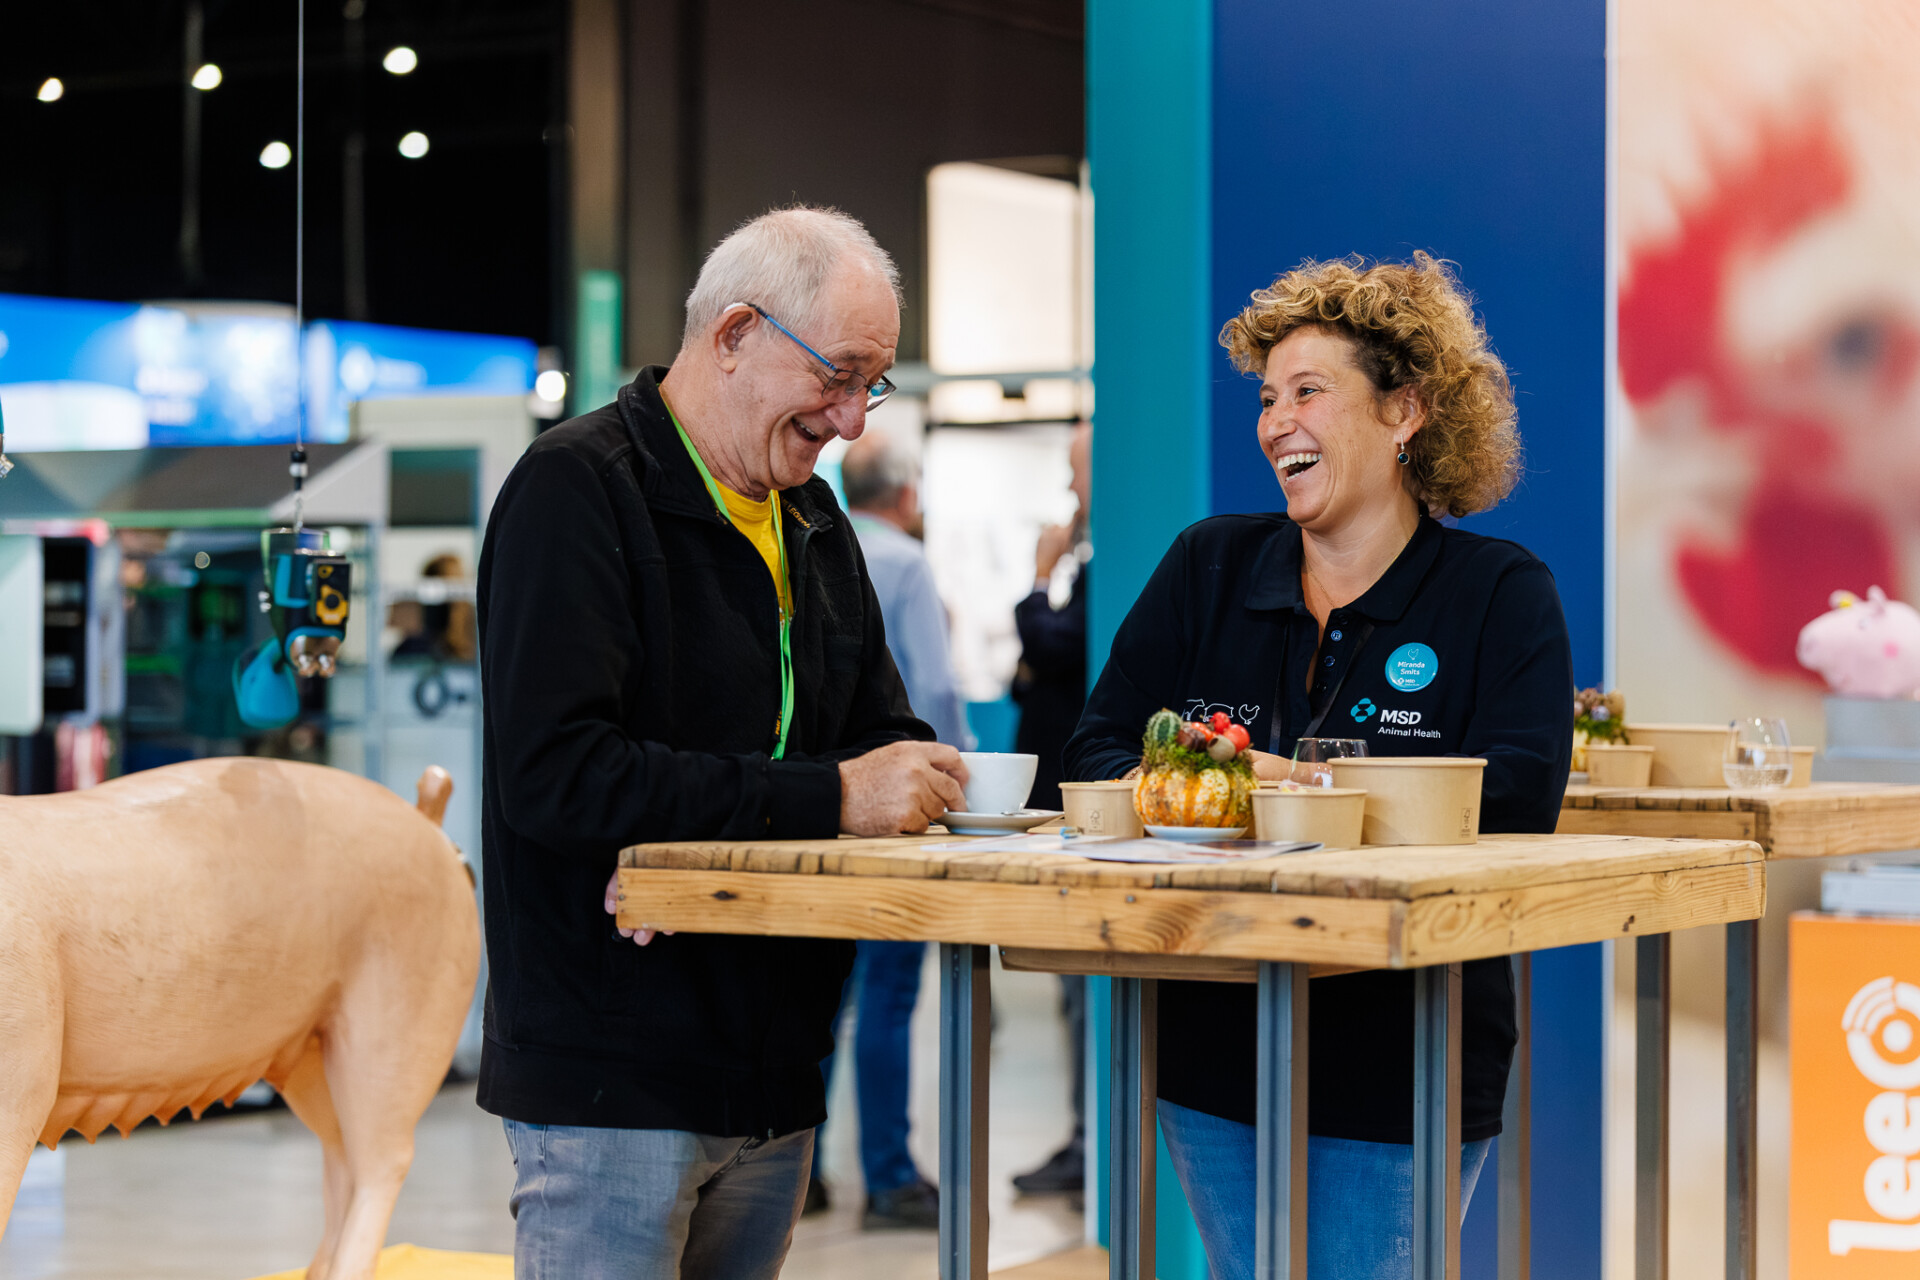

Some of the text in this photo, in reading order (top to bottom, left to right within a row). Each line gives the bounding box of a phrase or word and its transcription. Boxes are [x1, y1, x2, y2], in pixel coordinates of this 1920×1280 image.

[1397, 661, 1425, 669] Miranda
[1400, 668, 1420, 676] Smits
[1380, 709, 1422, 725] MSD
[1377, 726, 1441, 739] Animal Health
